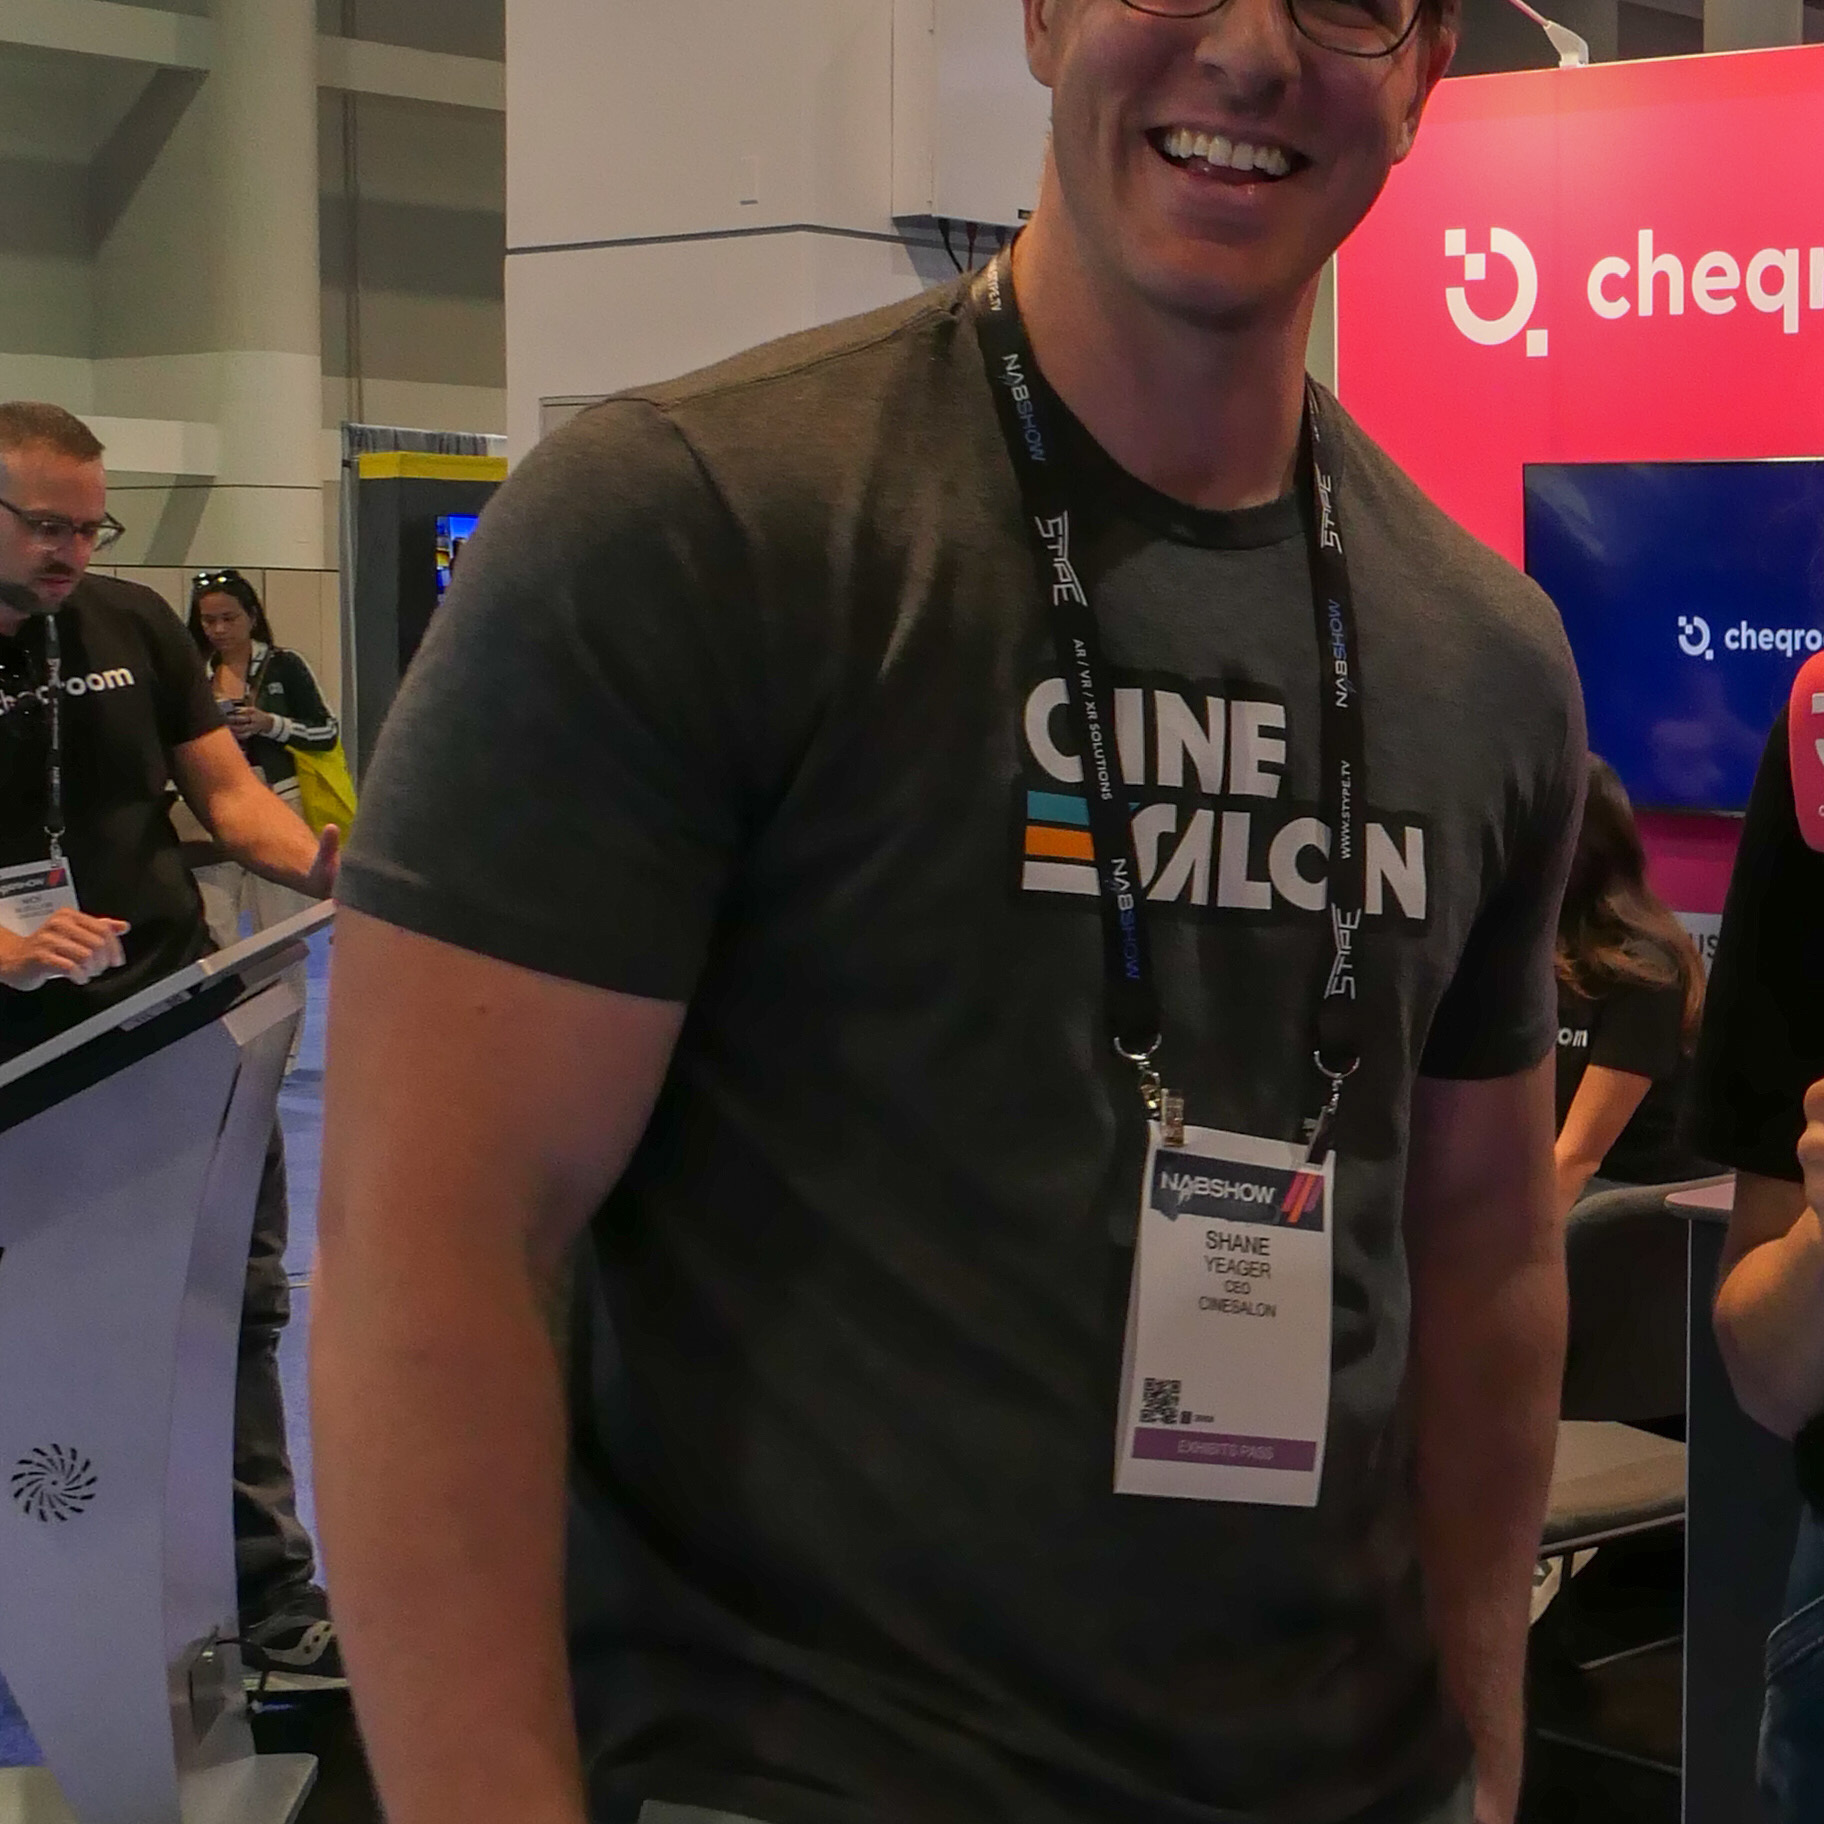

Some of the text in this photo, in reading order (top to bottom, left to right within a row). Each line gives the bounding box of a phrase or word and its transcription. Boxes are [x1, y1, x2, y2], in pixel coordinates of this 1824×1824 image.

[1023, 677, 1287, 798] CINE
[1205, 1230, 1271, 1256] SHANE
[1203, 1255, 1272, 1279] YEAGER
